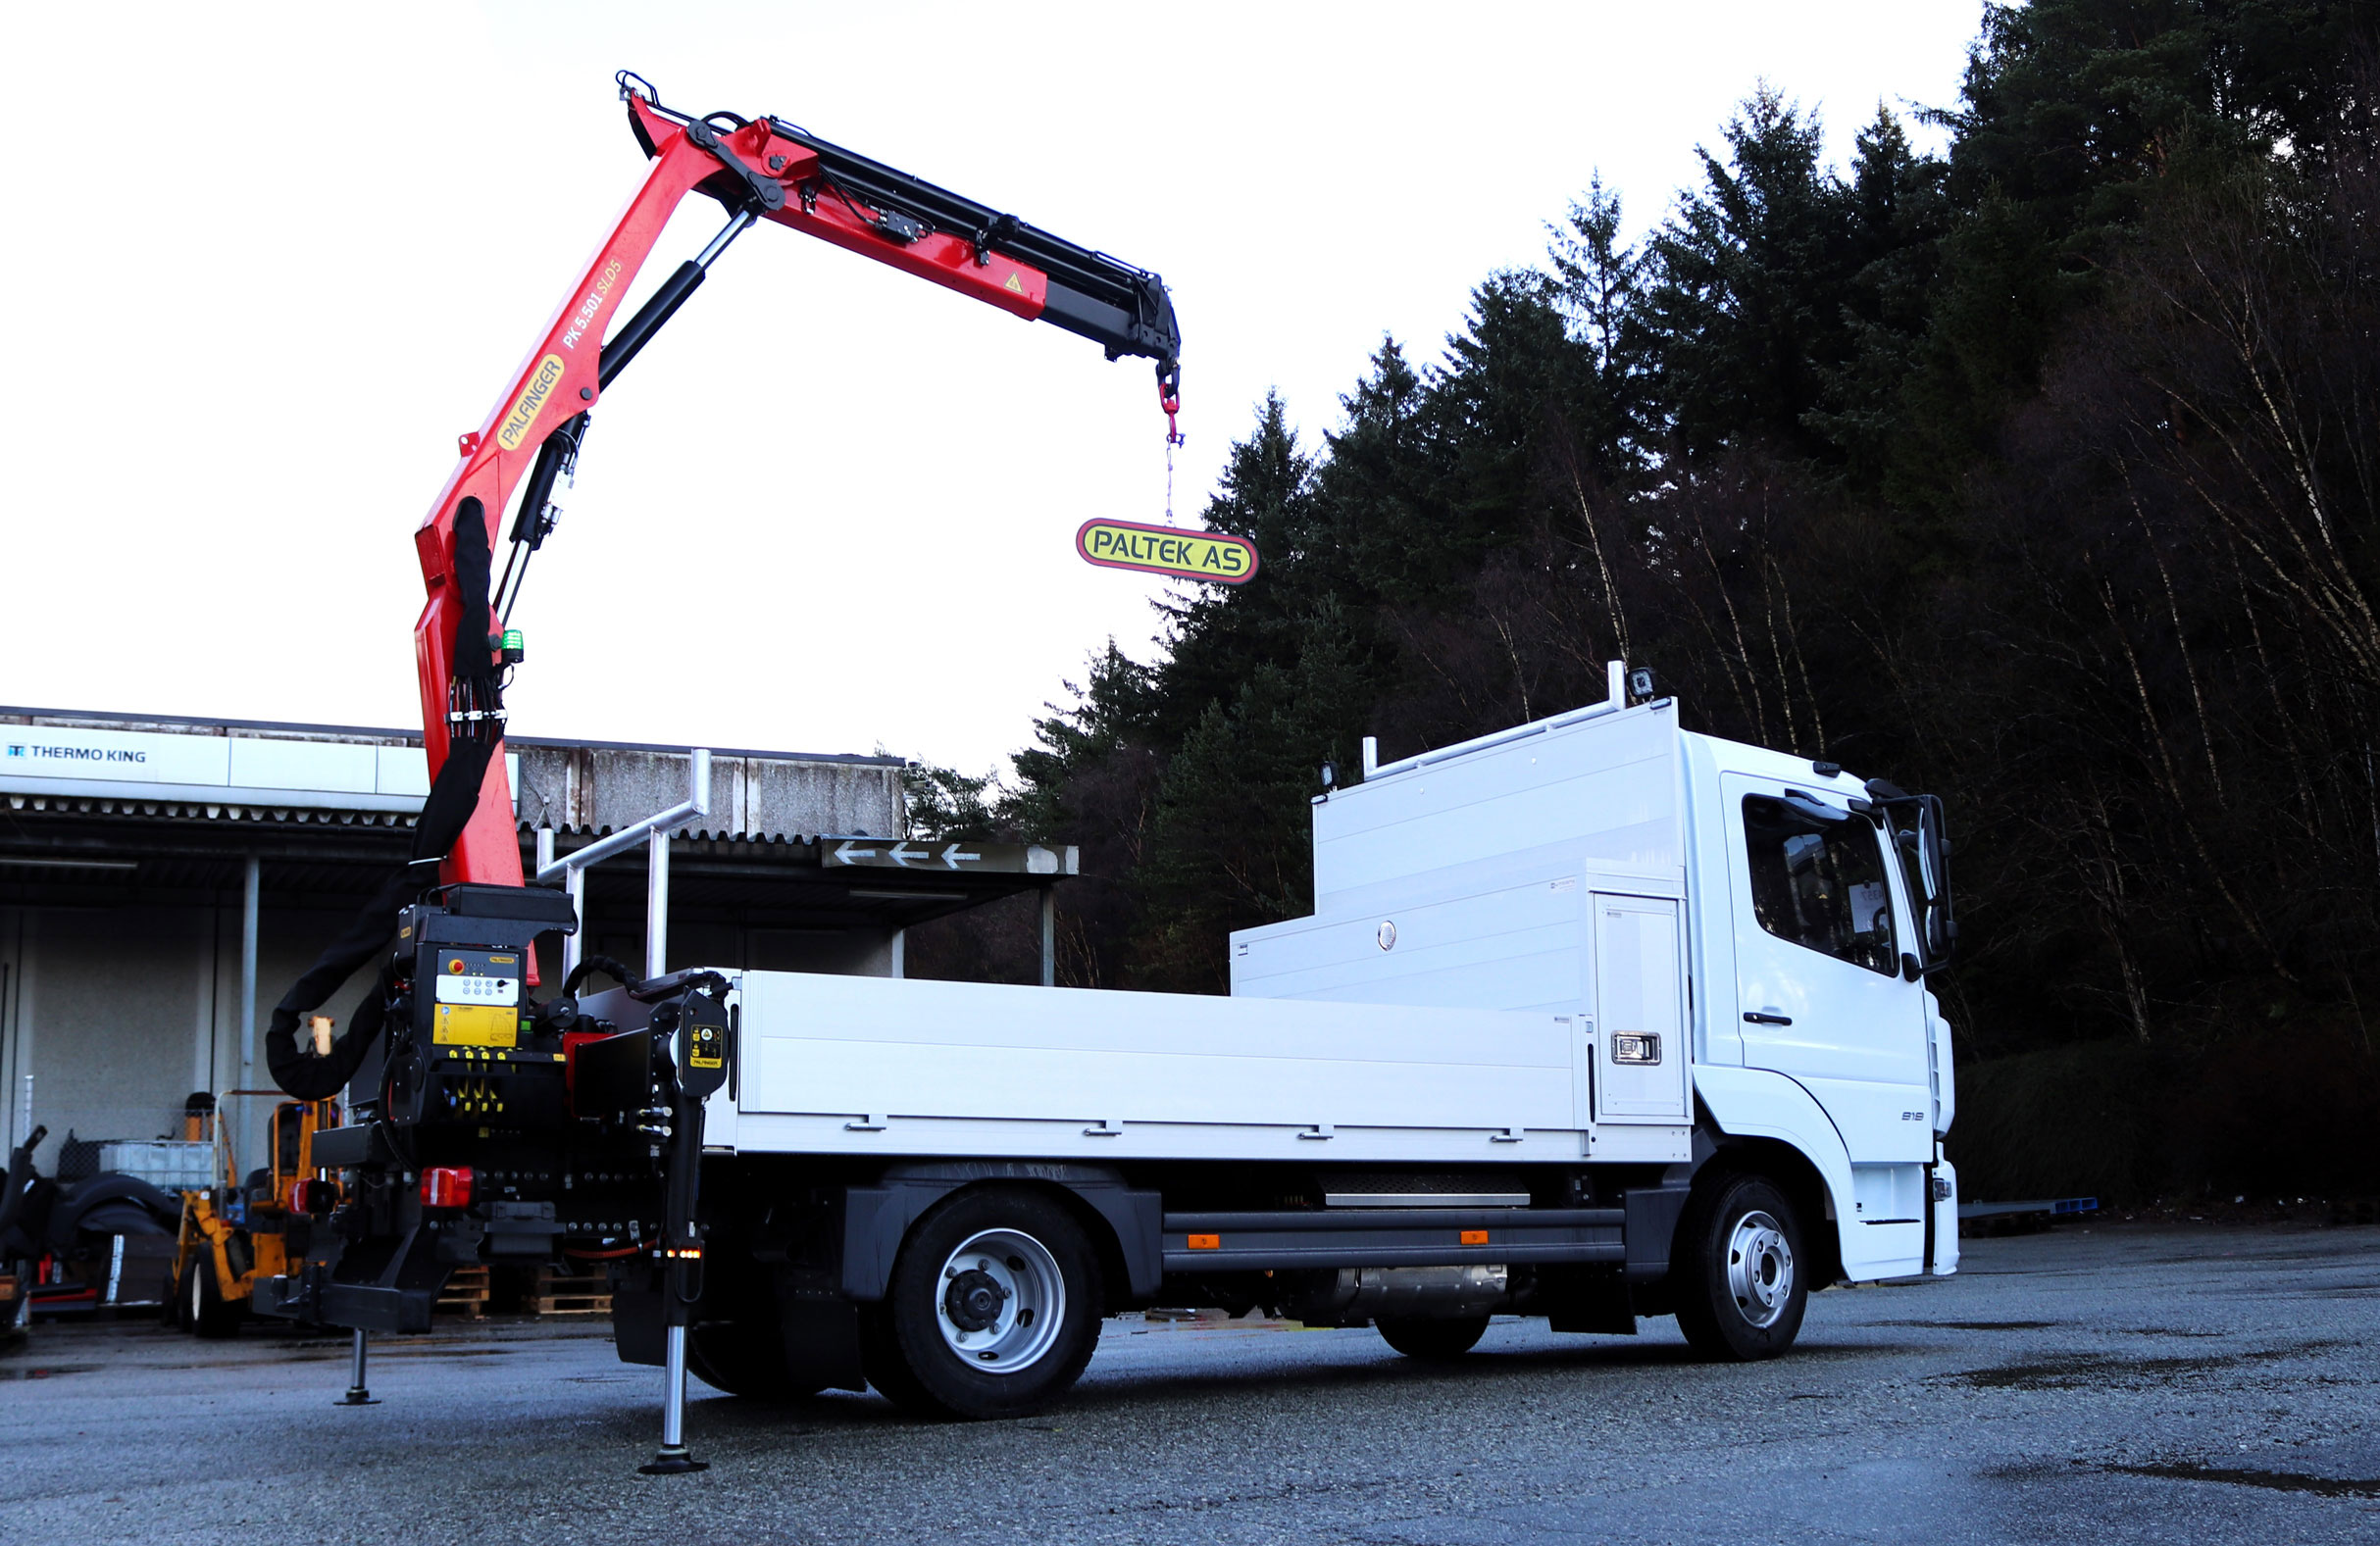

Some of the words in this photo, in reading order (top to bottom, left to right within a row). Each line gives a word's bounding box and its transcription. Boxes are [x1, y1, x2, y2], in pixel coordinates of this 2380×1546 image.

[562, 326, 582, 350] PK
[576, 292, 603, 330] 5.501
[501, 360, 561, 446] PALFINGER
[1093, 530, 1193, 566] PALTEK
[1201, 545, 1241, 572] AS
[30, 745, 103, 761] THERMO
[106, 749, 146, 763] KING
